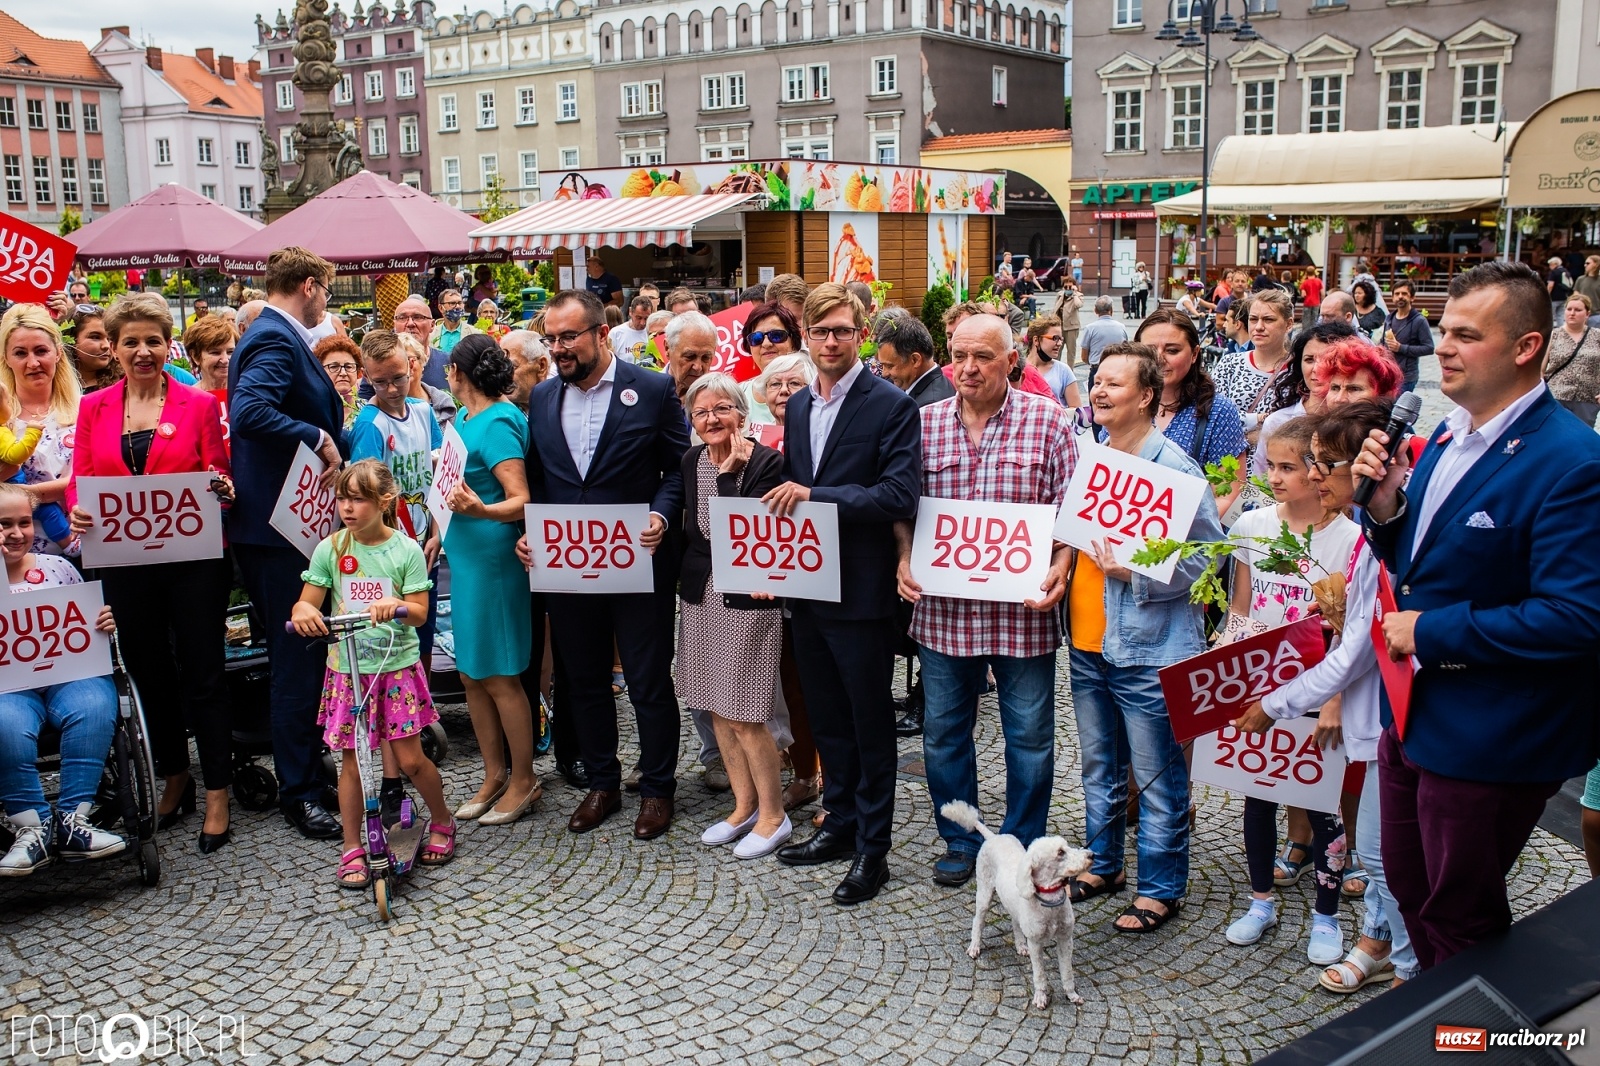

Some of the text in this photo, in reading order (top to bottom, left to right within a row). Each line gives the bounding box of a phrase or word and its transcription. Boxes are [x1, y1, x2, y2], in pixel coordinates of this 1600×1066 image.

[1560, 116, 1589, 124] BROWAR
[88, 253, 180, 270] Gelateria Ciao Italia
[224, 259, 254, 272] Gelateria
[361, 260, 384, 270] Ciao
[387, 258, 419, 269] Italia
[444, 441, 461, 481] DUDA
[98, 488, 201, 518] DUDA
[1087, 463, 1173, 519] DUDA
[102, 512, 203, 543] 2020
[289, 489, 331, 541] 2020
[729, 513, 821, 545] DUDA
[934, 514, 1032, 546] DUDA
[1077, 492, 1168, 543] 2020
[543, 519, 633, 545] DUDA
[546, 544, 635, 569] 2020
[731, 541, 823, 572] 2020
[931, 541, 1032, 574] 2020
[350, 582, 383, 592] DUDA
[350, 591, 383, 600] 2020
[1188, 640, 1302, 694] DUDA
[1191, 660, 1305, 715] 2020
[1217, 725, 1324, 762] DUDA
[1214, 743, 1324, 785] 2020
